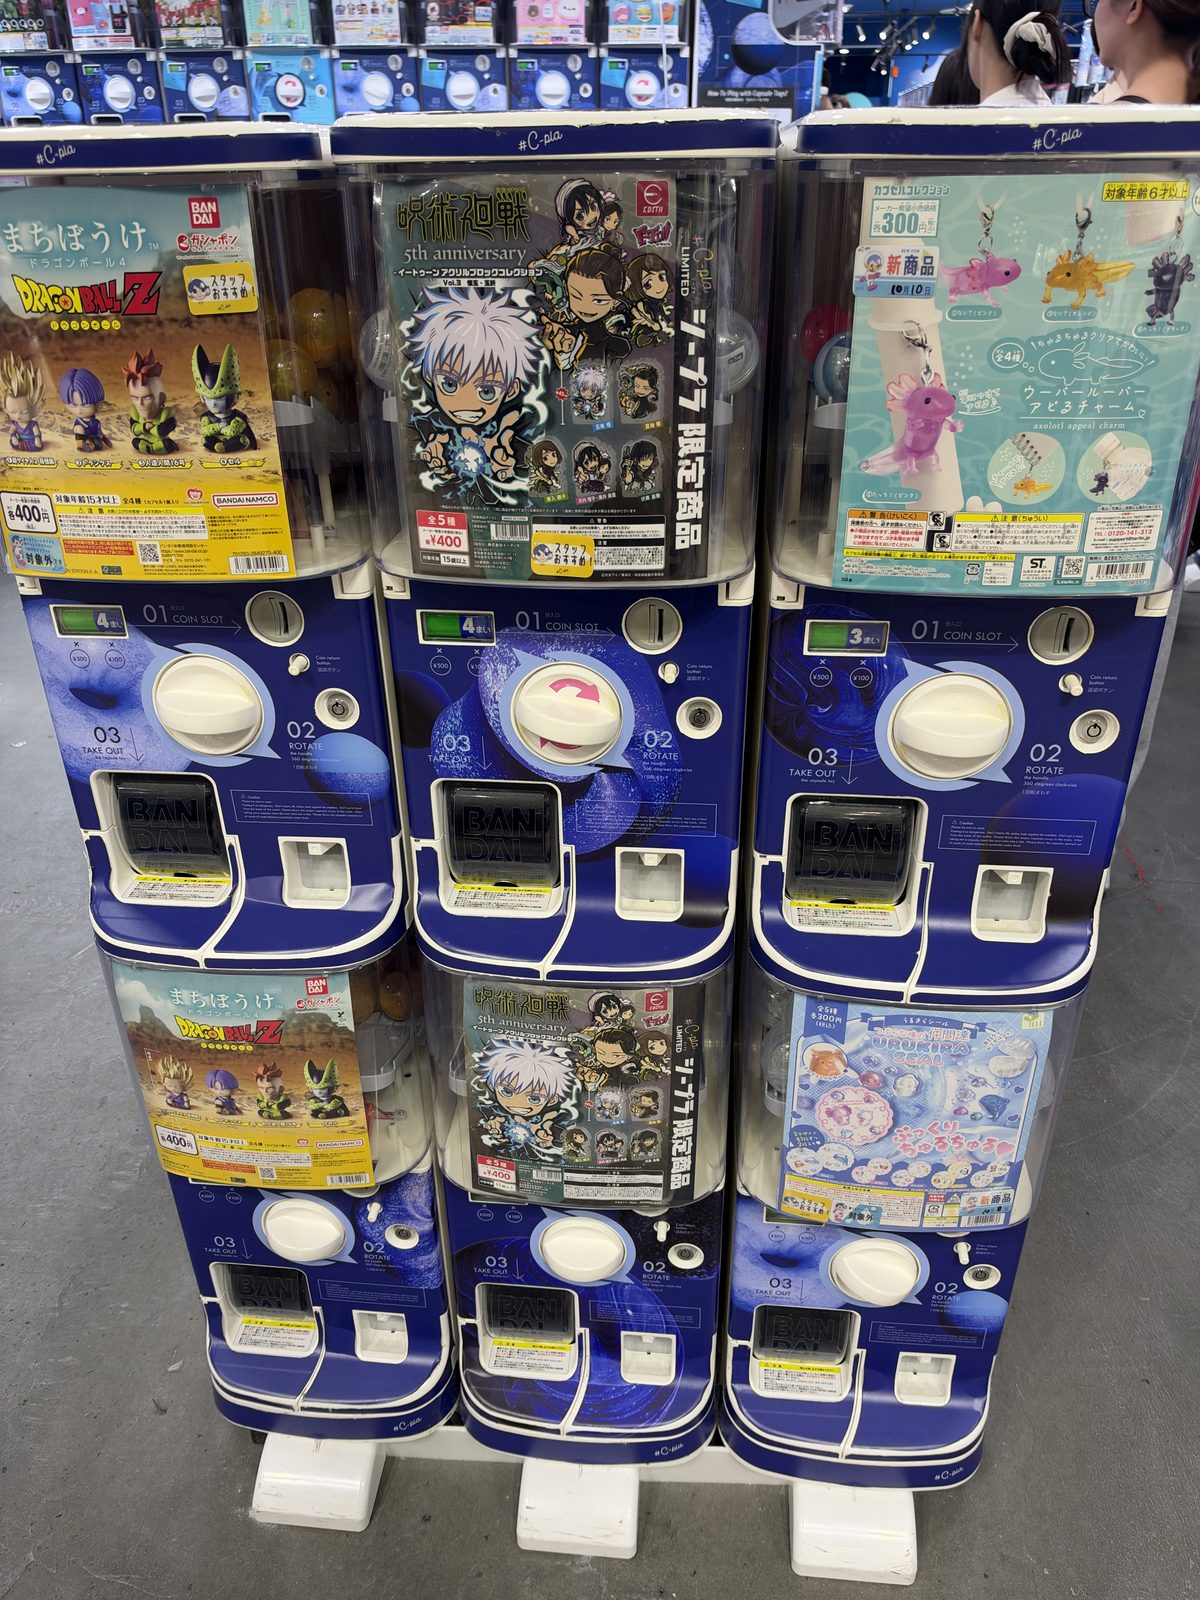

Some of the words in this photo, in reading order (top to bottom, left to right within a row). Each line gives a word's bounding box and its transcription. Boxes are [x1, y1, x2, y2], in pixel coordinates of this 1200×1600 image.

[518, 129, 563, 151] #C-pla
[1032, 128, 1082, 150] #C-pla
[36, 144, 76, 165] #C-pla
[874, 184, 950, 196] カプセルコレクション
[1104, 186, 1188, 200] 対象年齢6才以上
[191, 202, 217, 213] BAN
[193, 213, 213, 225] DAI
[397, 192, 531, 244] 呪術廻戦
[873, 212, 927, 234] 各300円
[3, 221, 146, 254] まちぼうけ
[190, 233, 238, 245] ガシャポン
[30, 258, 127, 268] ドラゴンボール4
[404, 246, 428, 264] 5th
[434, 246, 526, 267] anniversary
[680, 246, 690, 296] LIMITED
[886, 254, 934, 276] 新商品
[211, 273, 246, 287] スタッフ
[399, 268, 440, 278] イートゥーン
[441, 268, 543, 278] アクリルブロックコレクション
[12, 274, 84, 314] DRAGON
[79, 278, 122, 316] BALL
[212, 286, 256, 300] おすすめ!
[891, 284, 931, 296] 10月10日
[678, 309, 708, 412] シープラ
[995, 354, 1020, 363] 全4種
[1030, 400, 1134, 414] アピるチャーム
[1034, 422, 1064, 430] axolotl
[1067, 422, 1096, 430] appeal
[675, 423, 706, 550] 限定商品
[56, 494, 119, 504] 対象年齢15才以上
[245, 496, 275, 504] NAMCO
[428, 514, 456, 526] 全5種
[1108, 529, 1152, 537] 0120-141-313
[430, 534, 462, 548] ¥400
[554, 543, 586, 554] スタッフ
[442, 556, 468, 564] 15歳以上
[554, 554, 593, 567] おすすめ!
[1030, 558, 1046, 568] ST
[143, 604, 168, 624] 01
[172, 614, 198, 624] COIN
[200, 614, 224, 624] SLOT
[515, 610, 541, 630] 01
[546, 622, 572, 632] COIN
[574, 622, 600, 632] SLOT
[911, 620, 938, 640] 01
[944, 631, 972, 640] COIN
[976, 632, 1002, 641] SLOT
[94, 726, 122, 744] 03
[287, 721, 316, 738] 02
[289, 742, 324, 750] ROTATE
[442, 735, 472, 752] 03
[644, 730, 672, 748] 02
[82, 746, 102, 755] TAKE
[104, 747, 124, 755] OUT
[643, 752, 678, 760] ROTATE
[808, 748, 838, 766] 03
[1030, 744, 1062, 762] 02
[428, 754, 448, 763] TAKE
[451, 754, 472, 764] OUT
[790, 768, 812, 778] TAKE
[816, 769, 836, 778] OUT
[1026, 766, 1064, 775] ROTATE
[128, 797, 200, 830] BAN
[462, 806, 538, 837] BAN
[130, 830, 190, 855] DAI
[814, 820, 894, 855] BAN
[462, 837, 523, 862] DAI
[810, 854, 874, 880] DAI
[307, 979, 326, 988] BAN
[308, 986, 323, 994] DAI
[170, 988, 274, 1010] まちぼうけ
[474, 986, 570, 1023] 呪術廻戦
[478, 1015, 496, 1026] 5th
[498, 1019, 568, 1034] anniversary
[872, 1035, 970, 1056] URUKIRA
[893, 1052, 944, 1066] SEAL
[674, 1058, 694, 1114] シープラ
[900, 1136, 998, 1158] ちゅるちゅる
[670, 1119, 694, 1190] 限定商品
[486, 1169, 511, 1180] ¥400
[214, 1236, 236, 1248] 03
[363, 1241, 386, 1254] 02
[485, 1256, 508, 1268] 03
[643, 1260, 666, 1273] 02
[769, 1278, 792, 1288] 03
[934, 1282, 958, 1294] 02
[932, 1294, 961, 1302] ROTATE
[502, 1294, 558, 1322] BAN
[774, 1315, 835, 1341] BAN
